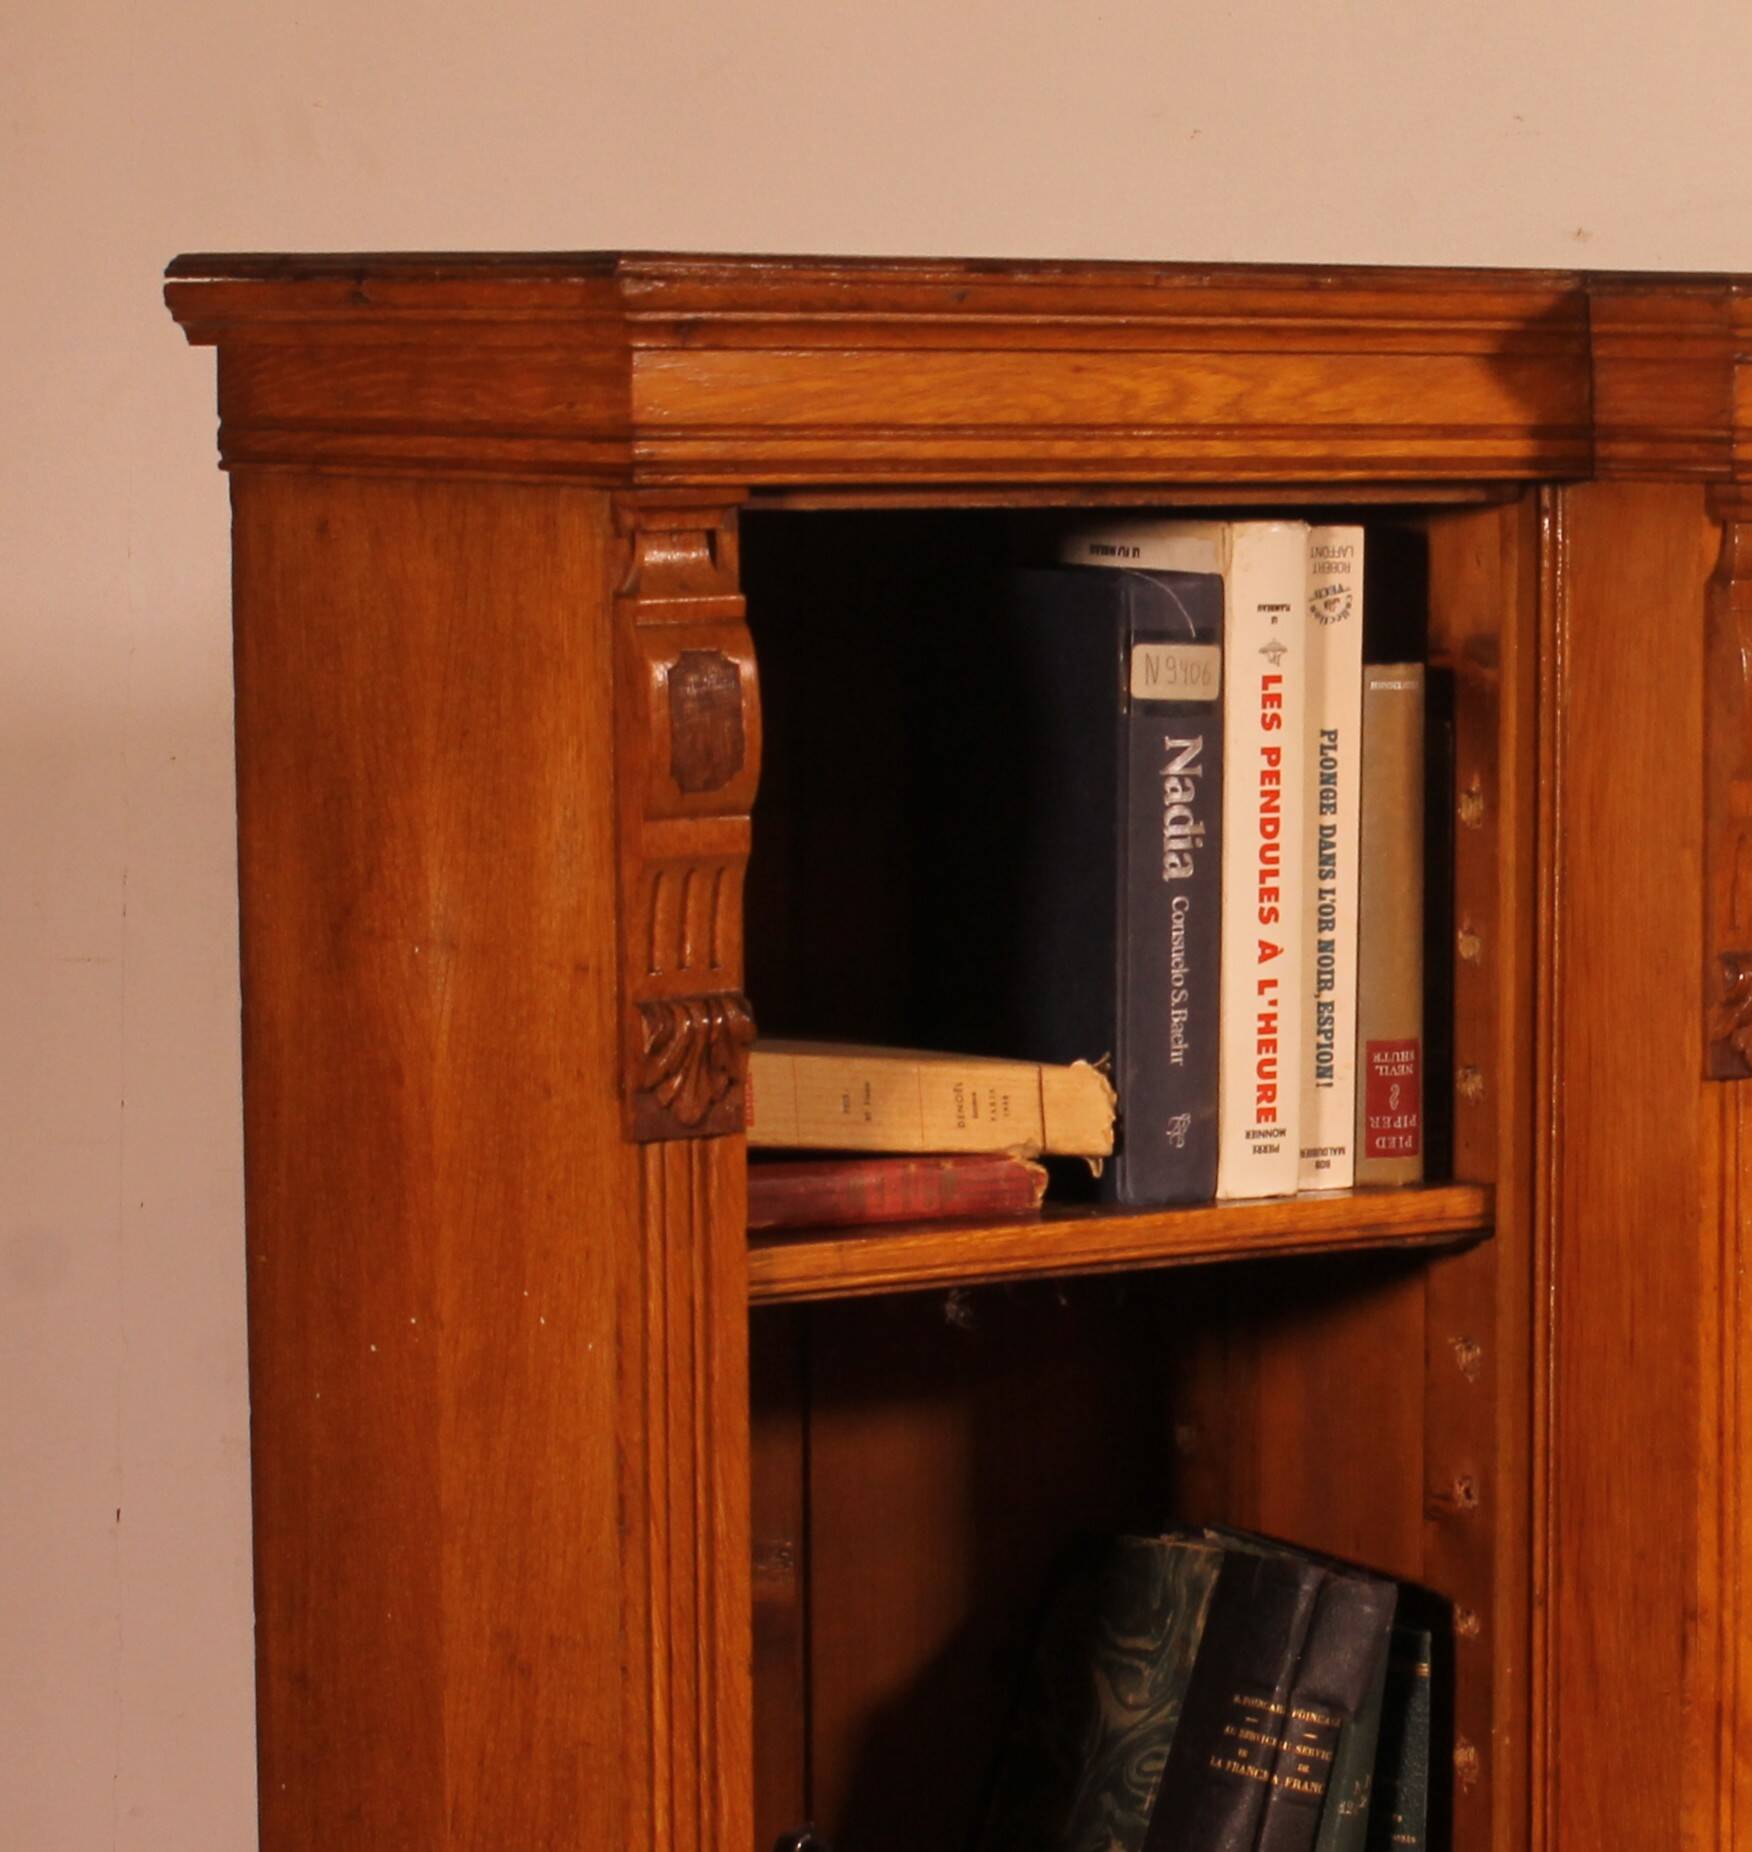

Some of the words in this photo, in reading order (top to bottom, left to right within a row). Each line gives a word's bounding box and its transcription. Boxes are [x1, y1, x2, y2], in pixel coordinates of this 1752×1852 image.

[1311, 546, 1354, 559] LAFFONT
[1313, 563, 1351, 575] ROBERT
[1260, 674, 1283, 731] LES
[1318, 728, 1339, 816] PLONGE
[1159, 734, 1206, 882] Nadia
[1258, 746, 1282, 925] PENDULES
[1317, 824, 1337, 881] DANS
[1316, 887, 1336, 934] L'OR
[1171, 896, 1190, 988] Consuelo
[1258, 938, 1284, 965] À
[1256, 979, 1278, 1124] L'HEURE
[1315, 1001, 1335, 1089] ESPION!
[1374, 1064, 1414, 1077] NEVIL
[1245, 1127, 1287, 1140] MONNIER
[1370, 1113, 1417, 1130] PIPER
[1374, 1135, 1413, 1150] PIED
[1252, 1144, 1280, 1155] PIERRE
